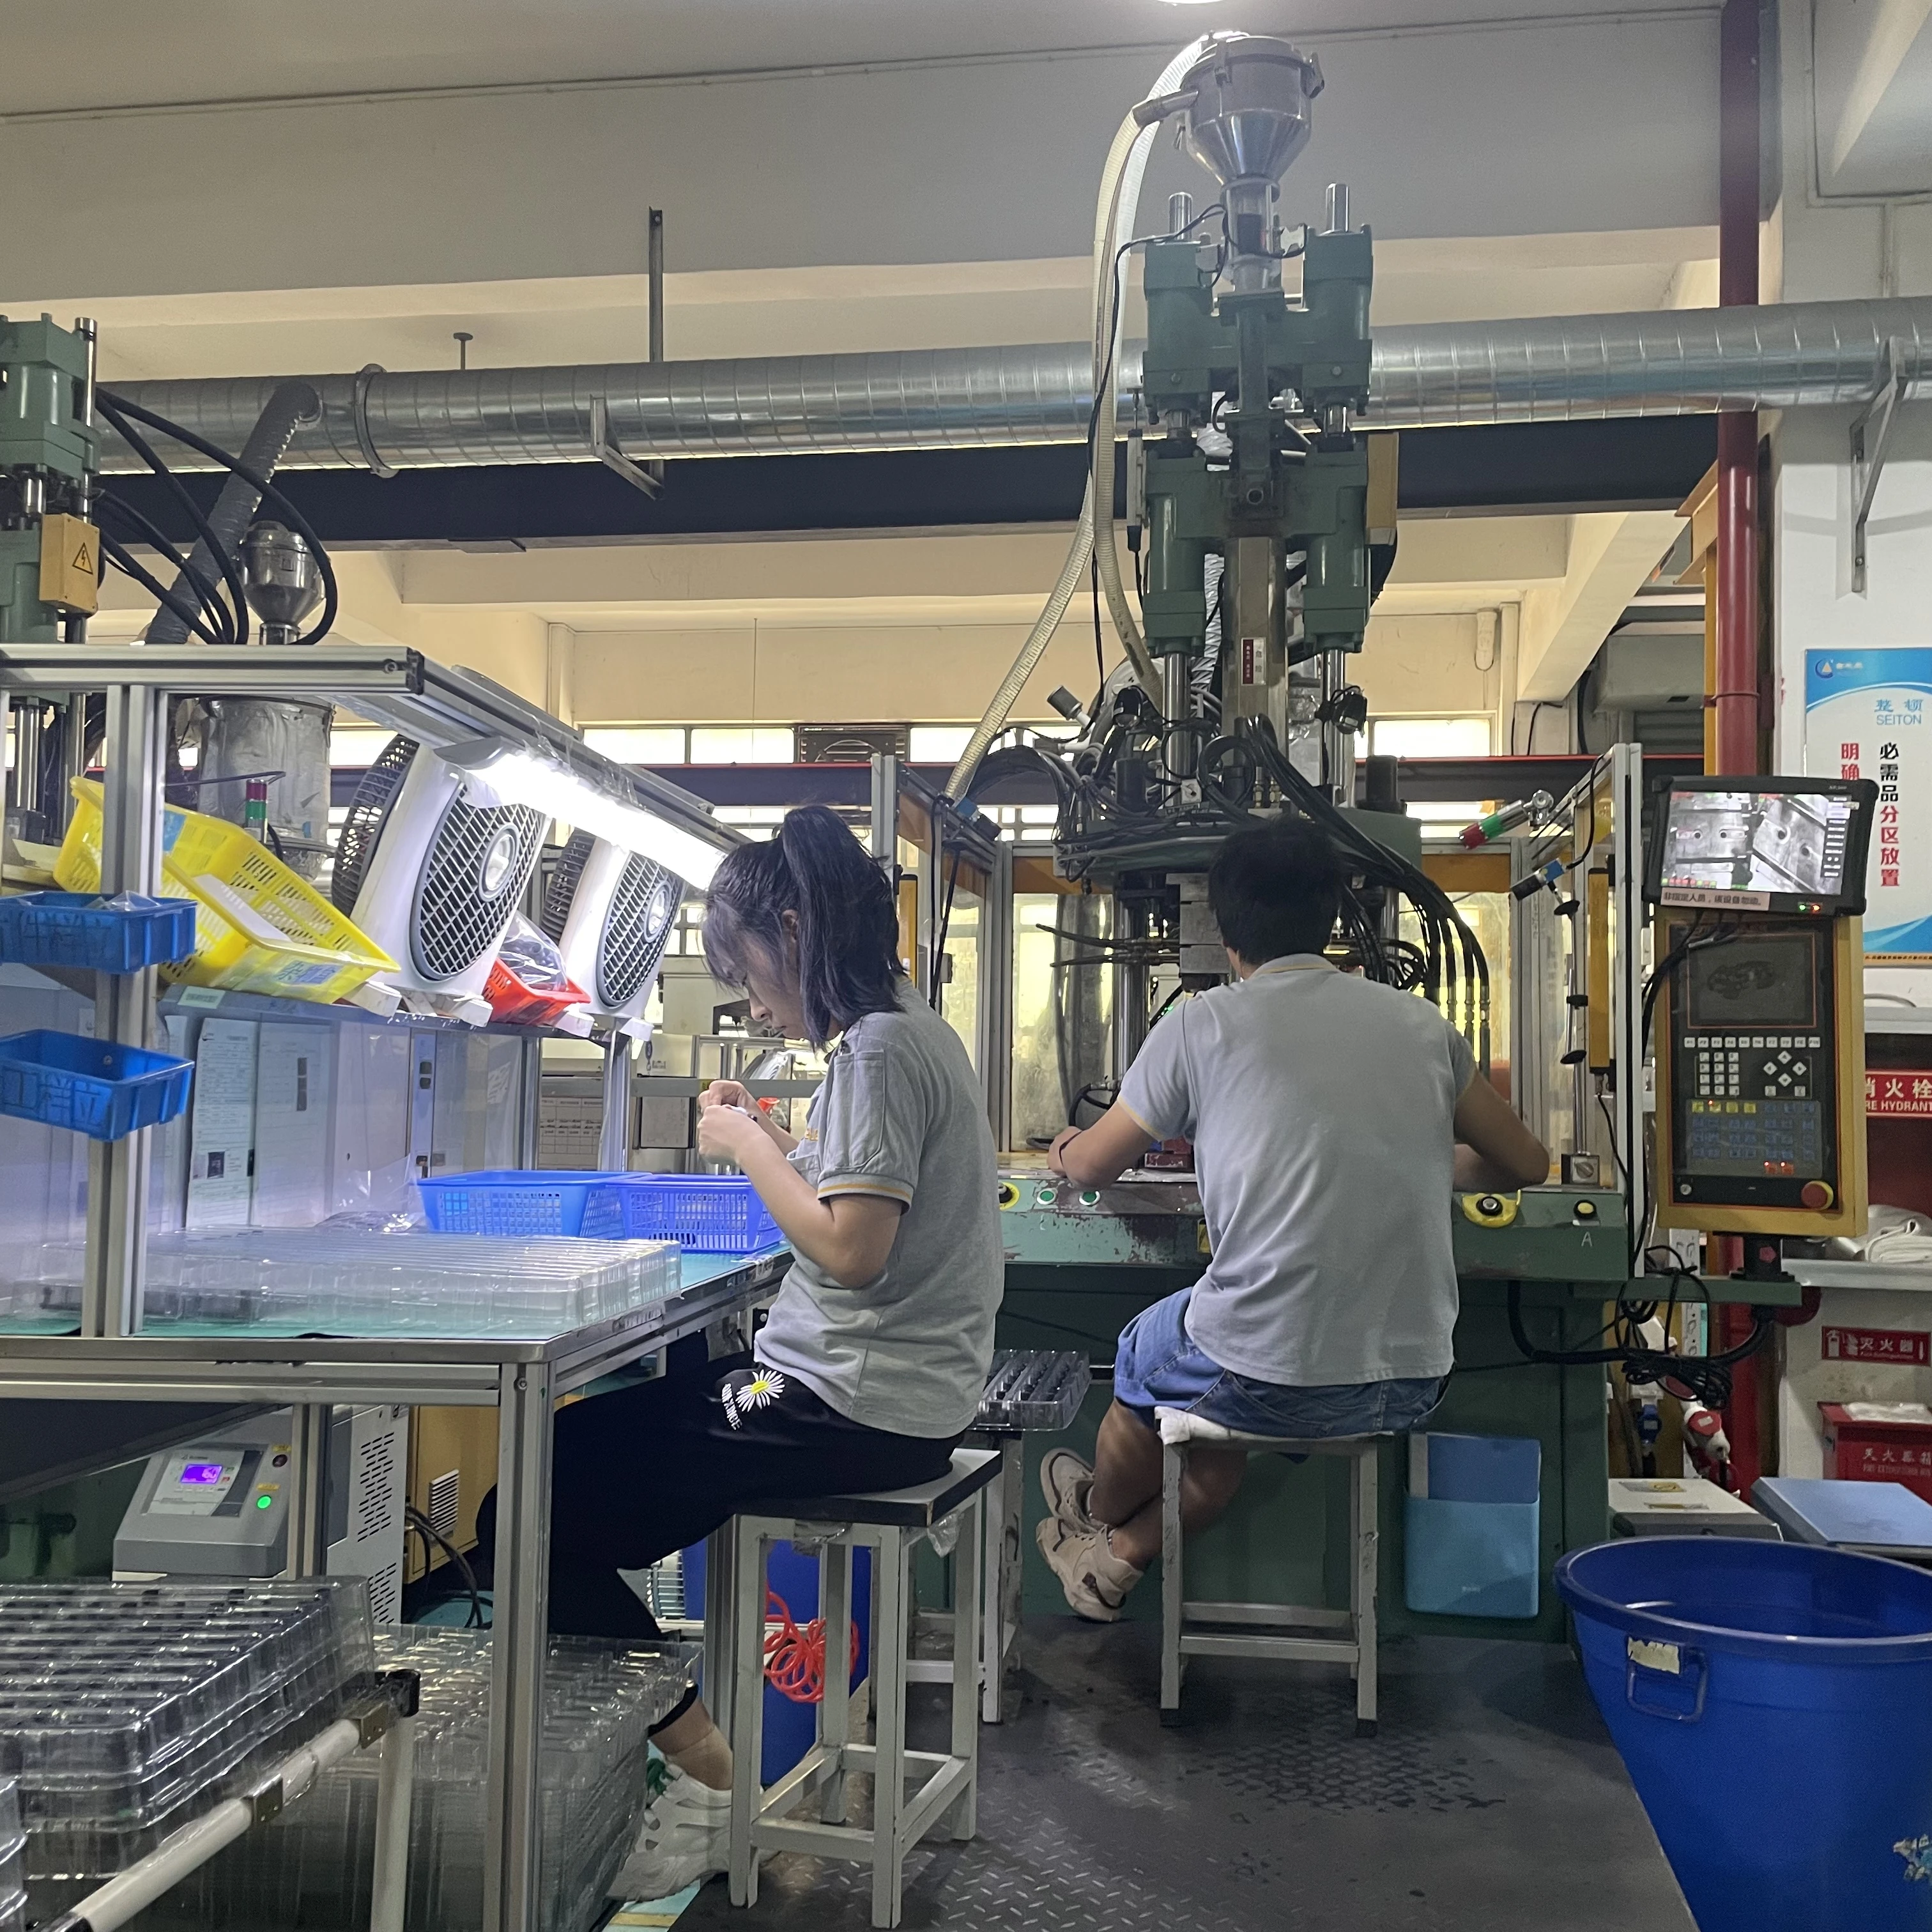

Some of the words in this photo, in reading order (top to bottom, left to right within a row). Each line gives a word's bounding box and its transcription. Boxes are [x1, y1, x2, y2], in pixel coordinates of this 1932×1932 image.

[1876, 714, 1922, 726] SEITON
[1880, 741, 1899, 887] 必需品分区放置
[1581, 1231, 1593, 1247] A
